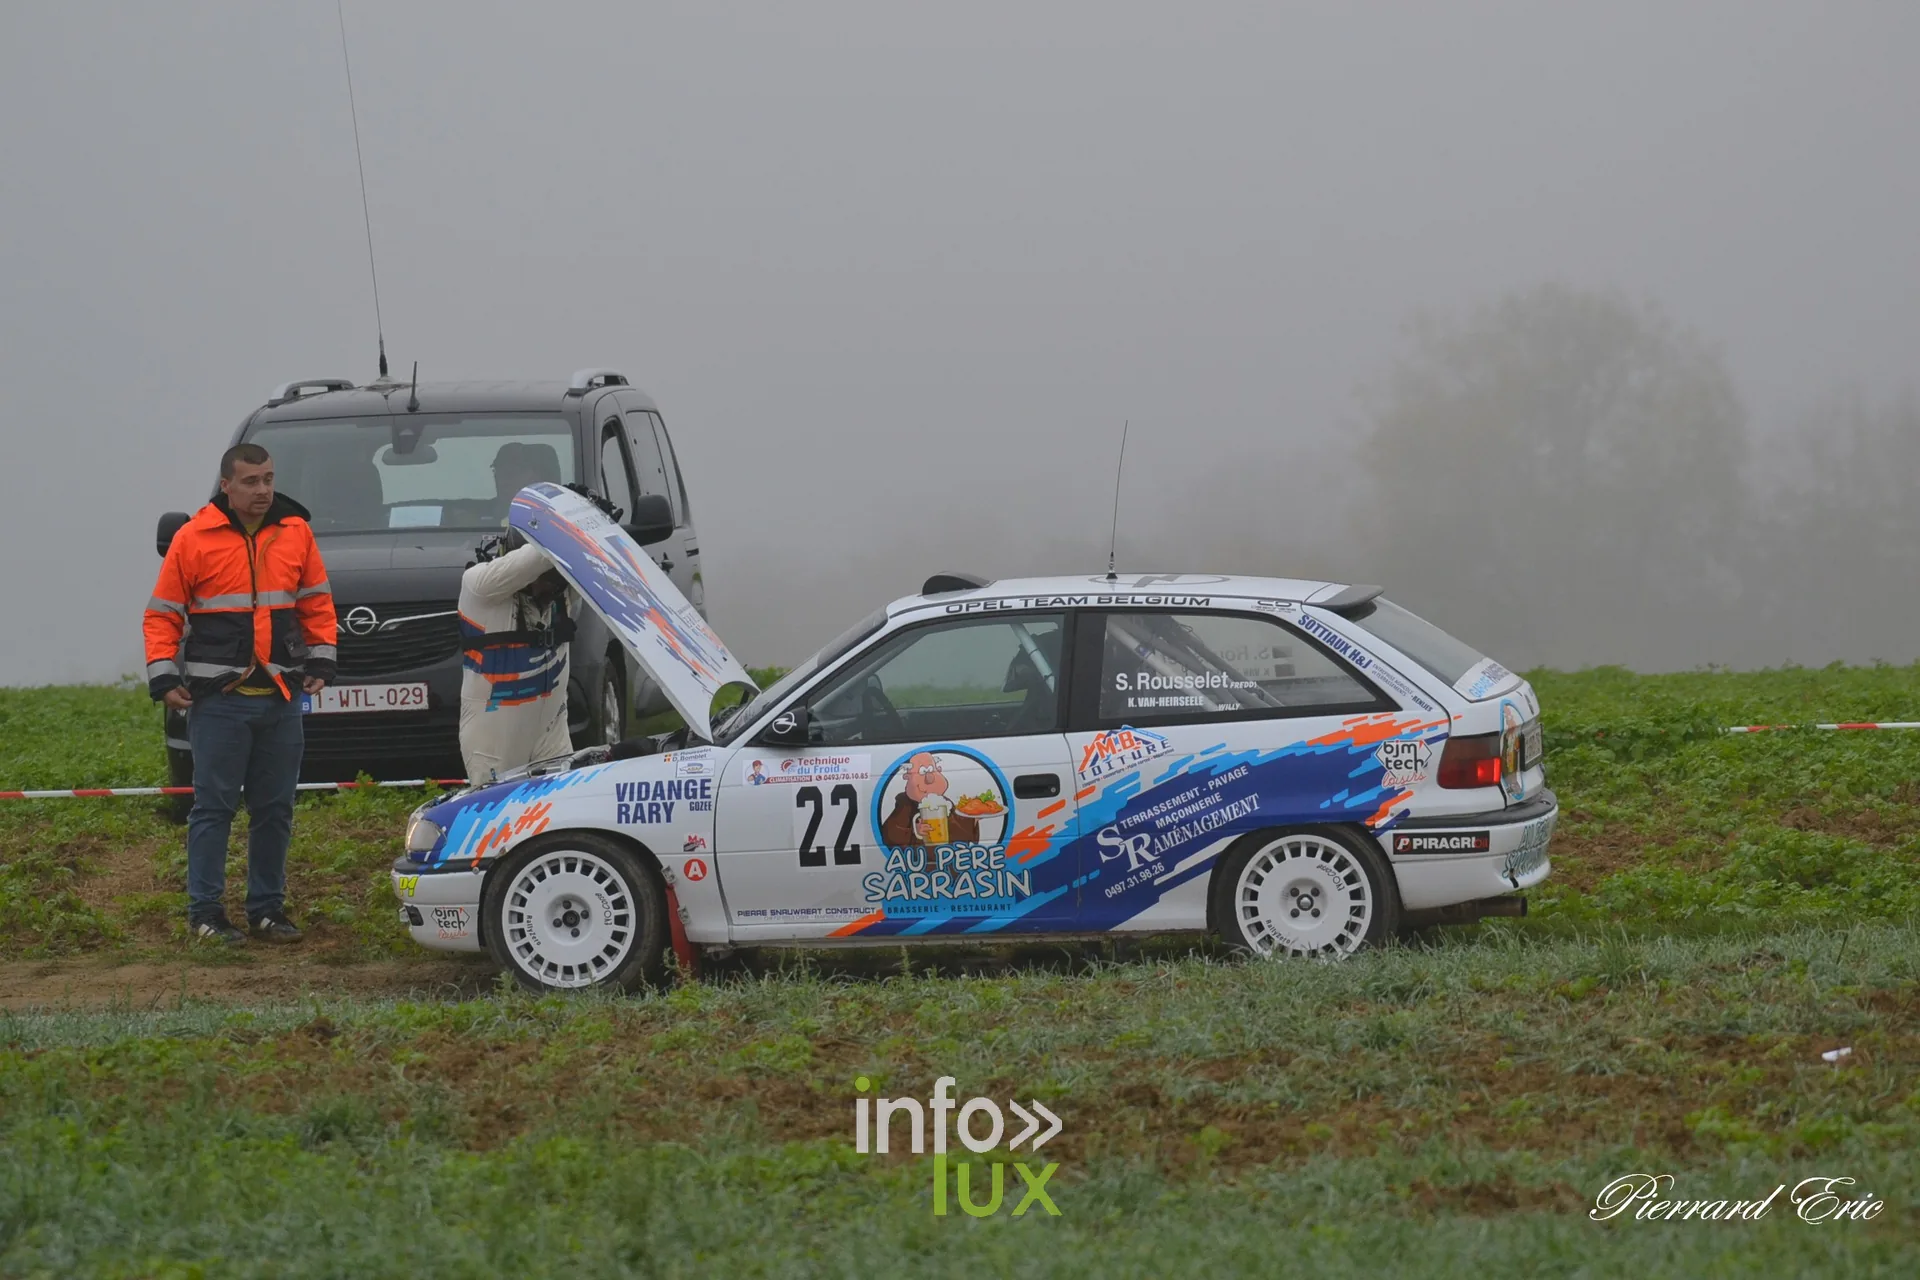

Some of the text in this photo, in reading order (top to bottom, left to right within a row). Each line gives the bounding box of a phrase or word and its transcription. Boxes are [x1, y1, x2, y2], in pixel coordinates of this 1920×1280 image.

[945, 596, 1210, 614] OPEL TEAM BELGIUM
[1298, 614, 1373, 669] SOTTIAUX H&J
[1115, 672, 1133, 691] S.
[1137, 671, 1229, 690] Rousselet
[302, 702, 310, 711] B
[317, 686, 423, 709] 1-WTL-029
[1078, 739, 1171, 780] TOITURE
[1383, 740, 1417, 758] bjm
[797, 766, 810, 775] du
[813, 764, 840, 774] Froid
[798, 756, 850, 767] Technique
[1385, 757, 1424, 773] tech
[615, 778, 712, 802] VIDANGE
[1119, 765, 1249, 829] TERRASSEMENT PAVAGE
[617, 801, 712, 825] RARY GOZEE
[1155, 792, 1223, 829] MAÇONNERIE
[796, 784, 862, 867] 22
[1153, 793, 1261, 855] AMÉNAGEMENT
[886, 842, 1006, 873] AU PÈRE
[688, 861, 704, 878] A
[1104, 862, 1165, 898] 0497.31.98.26
[863, 869, 1032, 901] SARRASIN
[434, 907, 460, 919] bjm
[737, 907, 876, 917] PIERRE SNAUWAERT CONSTRUCT
[887, 902, 1012, 914] BRASSERIE RESTAURANT
[437, 919, 466, 931] tech
